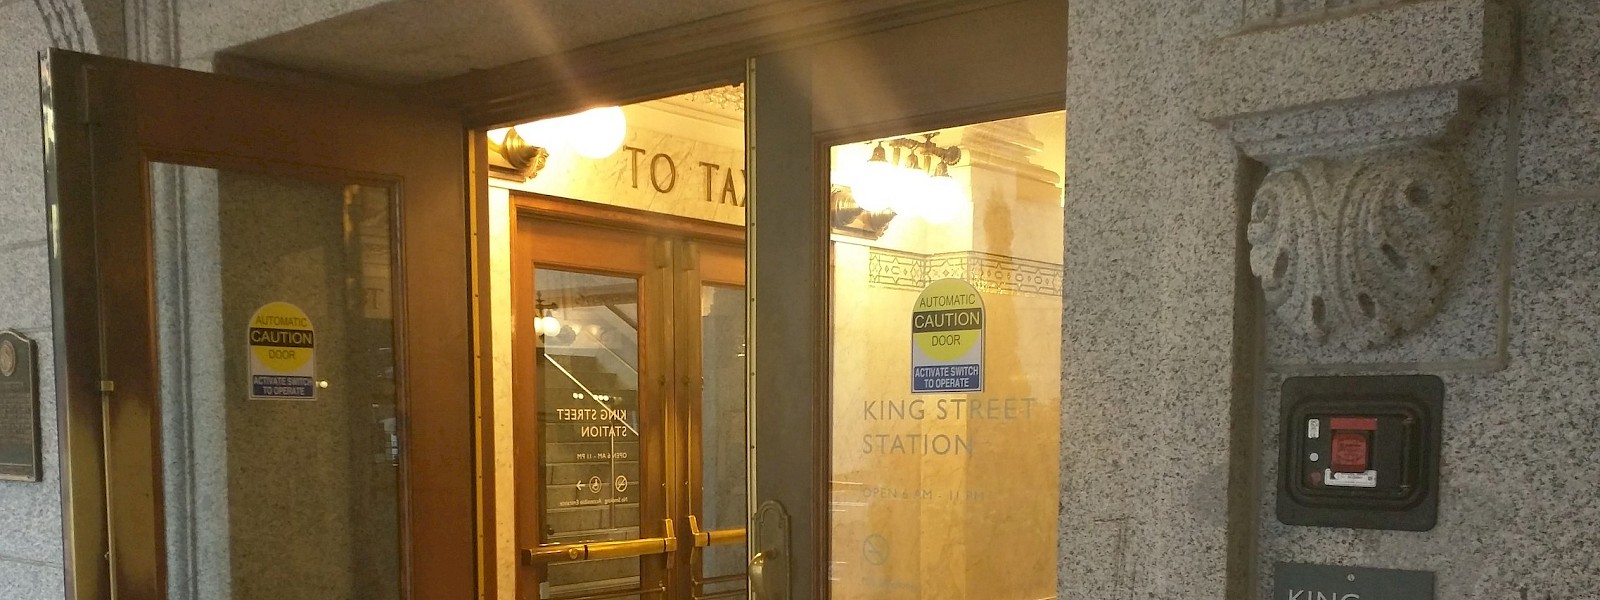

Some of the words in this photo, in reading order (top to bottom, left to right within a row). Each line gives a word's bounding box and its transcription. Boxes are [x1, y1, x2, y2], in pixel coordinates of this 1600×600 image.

[623, 145, 676, 194] TO
[699, 161, 746, 207] TA
[920, 293, 976, 308] AUTOMATIC
[256, 315, 308, 328] AUTOMATIC
[914, 311, 980, 329] CAUTION
[251, 330, 312, 345] CAUTION
[931, 334, 961, 347] DOOR
[268, 349, 296, 360] DOOR
[915, 367, 949, 378] ACTIVATE
[950, 366, 979, 377] SWITCH
[253, 375, 288, 386] ACTIVATE
[924, 379, 935, 388] TO
[936, 378, 969, 388] OPERATE
[262, 386, 274, 395] TO
[275, 386, 305, 396] OPERATE
[863, 399, 925, 421] KING
[936, 397, 1036, 420] STREET
[862, 433, 974, 456] STATION
[862, 487, 897, 499] OPEN
[914, 488, 933, 500] AM
[966, 490, 985, 501] PM
